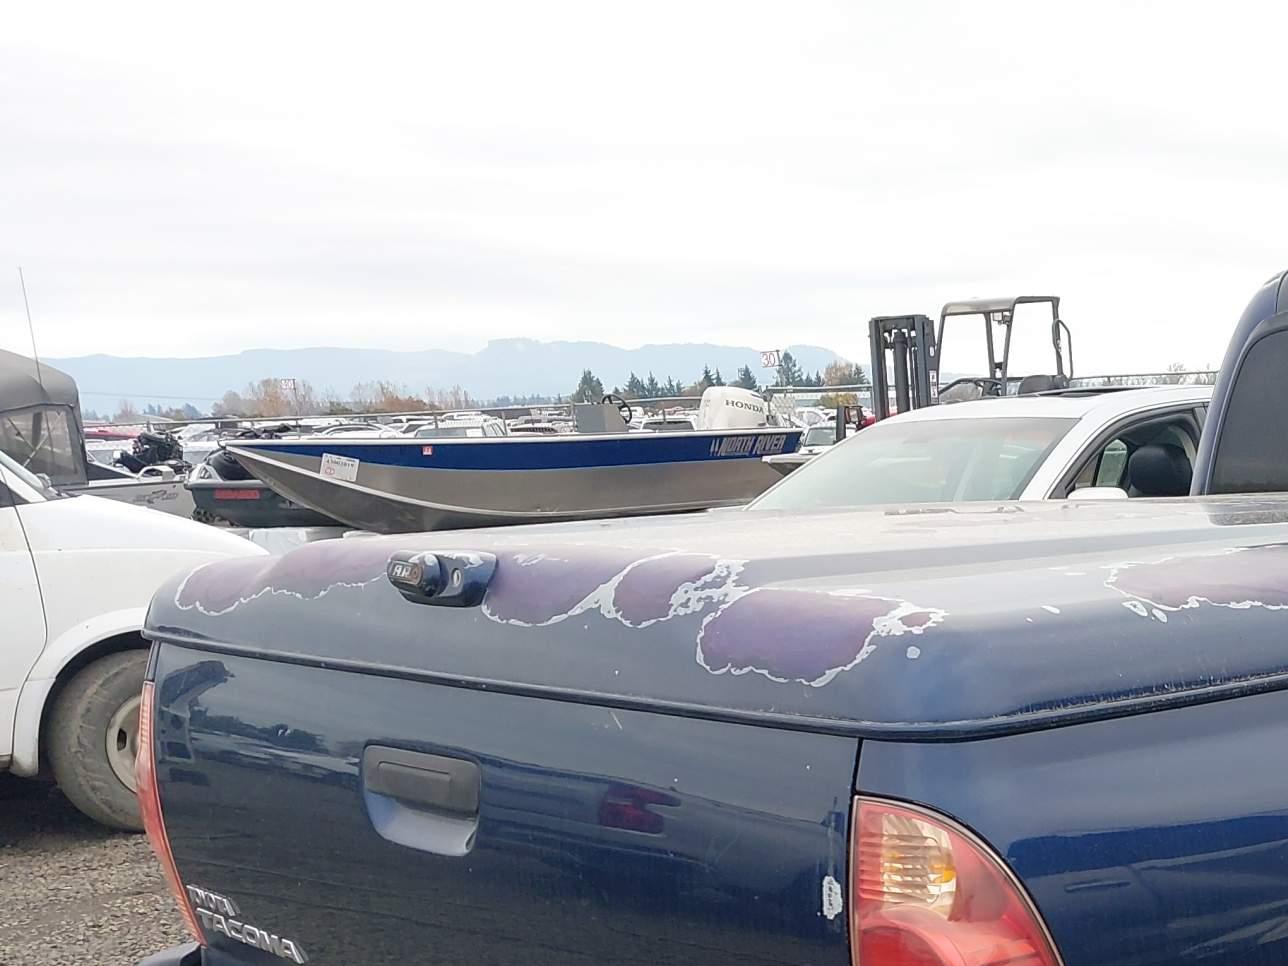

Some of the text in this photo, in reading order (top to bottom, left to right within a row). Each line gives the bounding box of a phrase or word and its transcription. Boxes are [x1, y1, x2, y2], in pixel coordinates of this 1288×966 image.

[762, 352, 776, 368] 30
[725, 399, 765, 414] HONDA
[752, 434, 787, 455] RIVER
[196, 907, 307, 965] TACOMA
